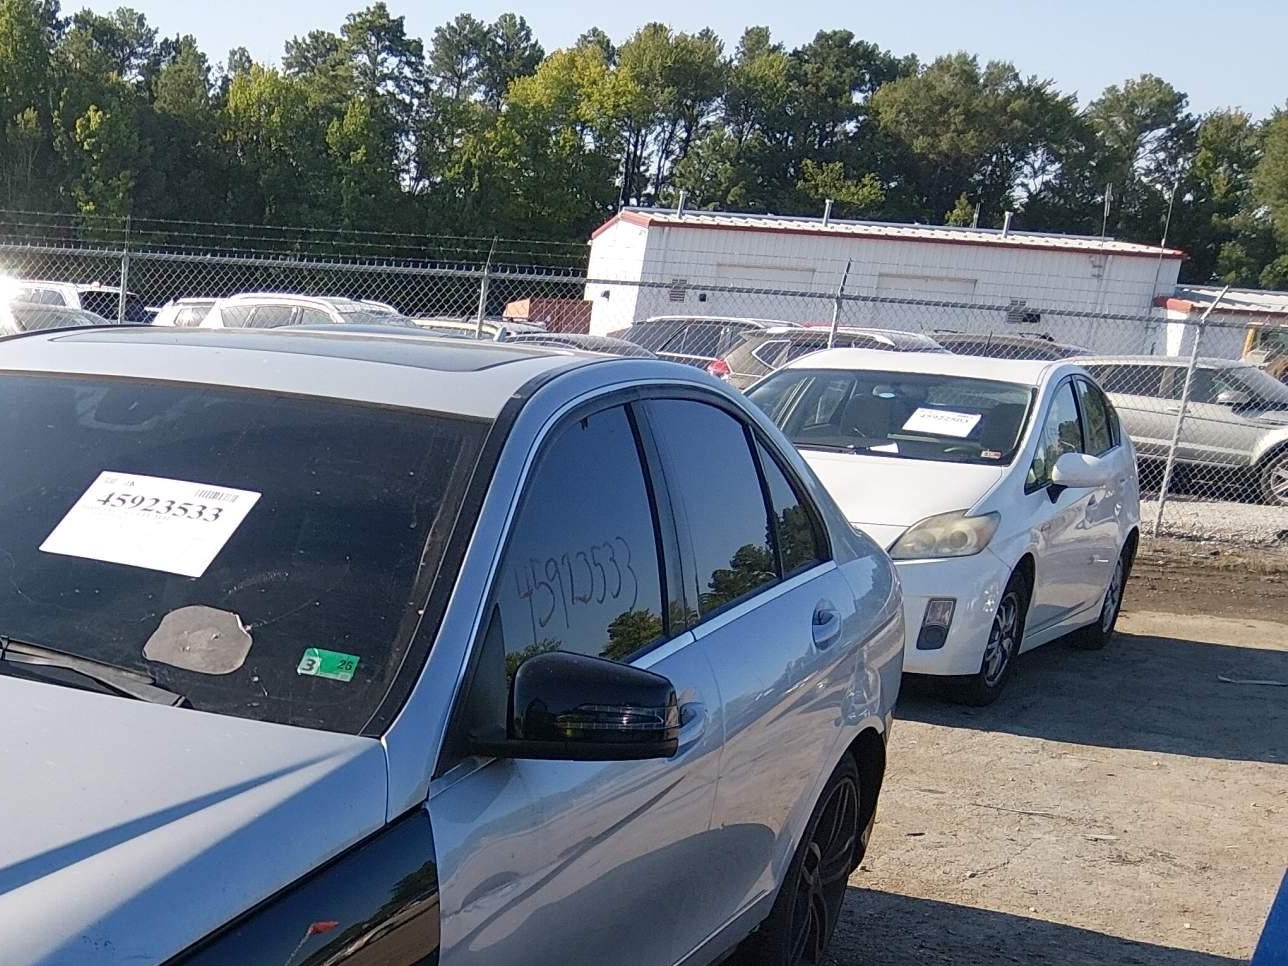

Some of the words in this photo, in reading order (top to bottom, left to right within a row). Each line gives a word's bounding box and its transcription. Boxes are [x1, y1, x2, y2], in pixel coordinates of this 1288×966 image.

[96, 491, 223, 523] 45923533
[302, 658, 317, 671] 3
[337, 659, 353, 671] 26
